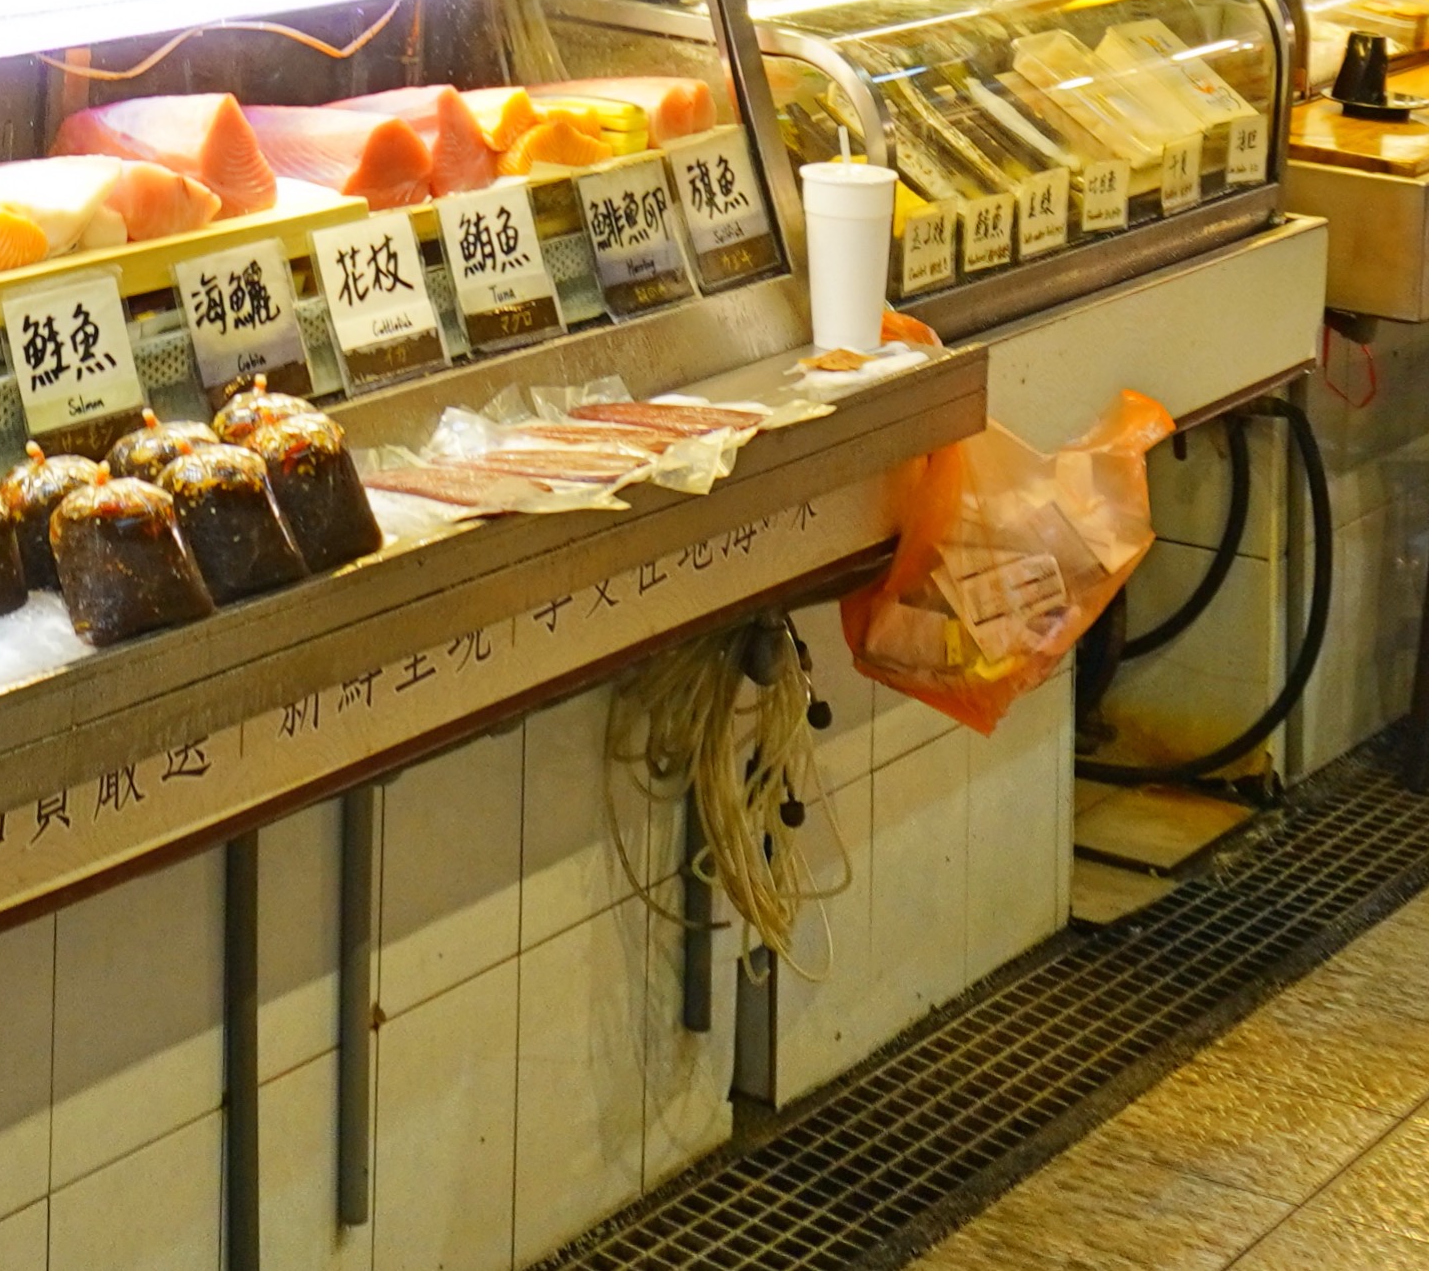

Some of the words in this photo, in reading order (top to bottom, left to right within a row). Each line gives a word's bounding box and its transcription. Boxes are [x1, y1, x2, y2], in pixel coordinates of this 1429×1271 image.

[686, 154, 750, 220] 旗魚
[335, 233, 415, 307] 花枝
[458, 205, 531, 278] 鮪魚
[489, 284, 518, 304] Tuna
[21, 302, 118, 393] 鮭魚
[68, 393, 105, 417] Salmon
